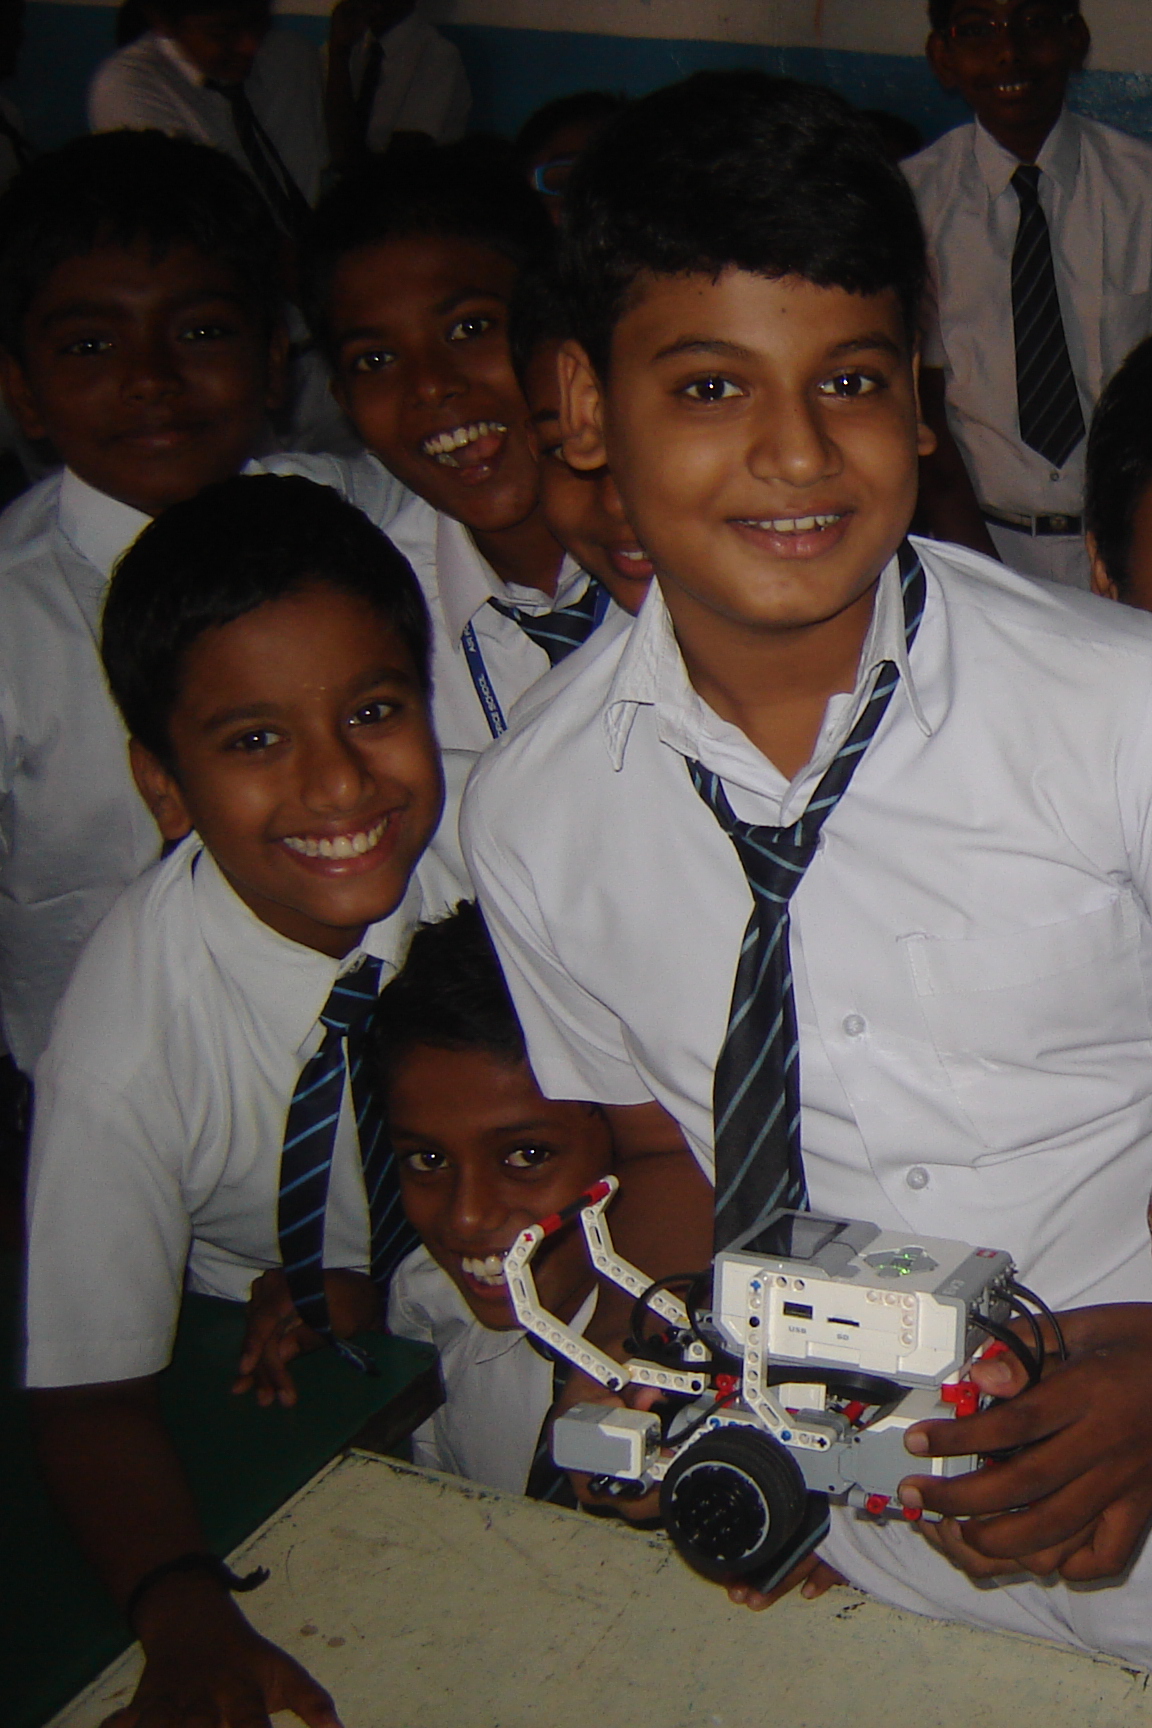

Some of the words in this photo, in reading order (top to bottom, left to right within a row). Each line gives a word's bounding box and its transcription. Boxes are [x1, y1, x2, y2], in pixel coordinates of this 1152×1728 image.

[479, 674, 496, 711] SCHOOL
[788, 1325, 807, 1334] USB
[836, 1333, 850, 1341] SD
